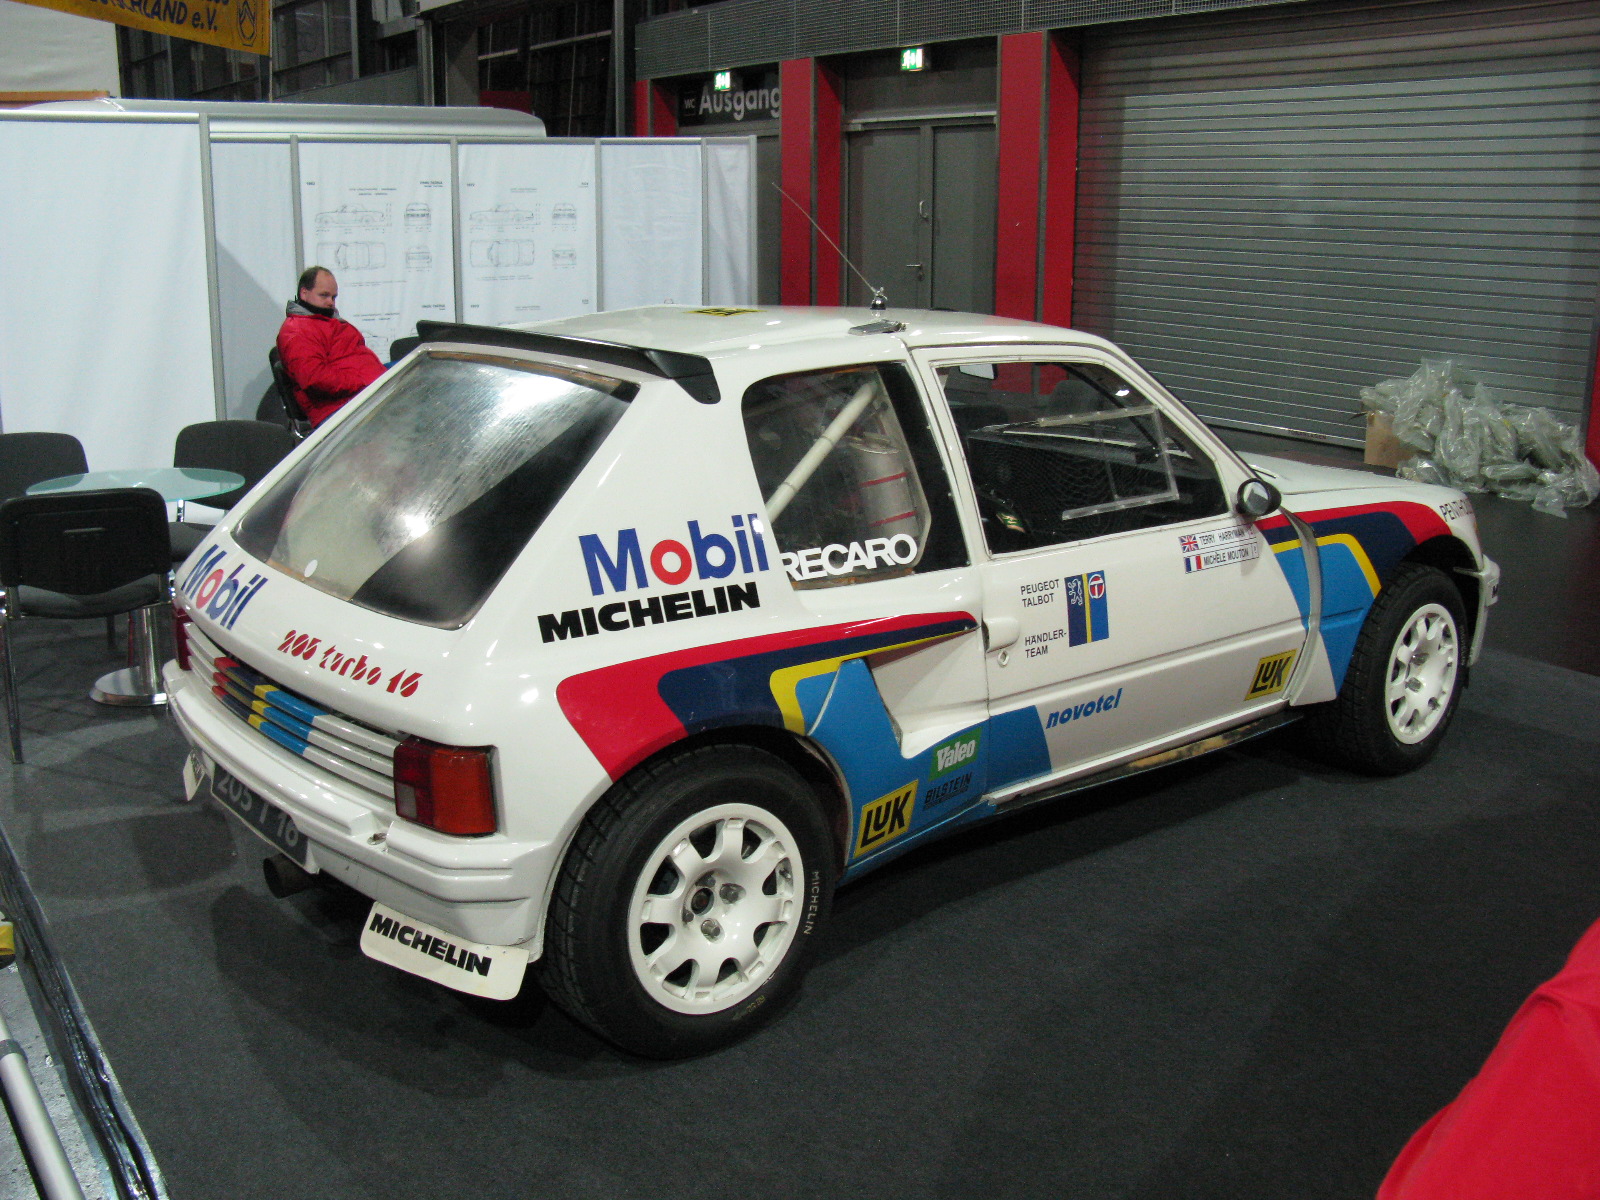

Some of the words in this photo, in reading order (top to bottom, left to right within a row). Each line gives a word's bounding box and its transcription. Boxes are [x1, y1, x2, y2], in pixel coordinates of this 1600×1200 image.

[191, 8, 218, 32] e.V.
[684, 99, 696, 109] WC
[699, 86, 781, 120] Ausgang
[1199, 535, 1216, 546] TERRY
[1218, 529, 1245, 542] HARRYMAN
[578, 513, 770, 596] Mobil
[780, 533, 918, 582] RECARO
[1203, 551, 1226, 565] MICHÈLE
[1227, 548, 1249, 561] MOUTON
[180, 544, 269, 631] Mobil
[1020, 579, 1060, 596] PEUGEOT
[1022, 593, 1055, 607] TALBOT
[537, 581, 761, 643] MICHELIN
[1024, 629, 1067, 646] HÄNDLER-
[1025, 645, 1049, 658] TEAM
[277, 629, 322, 661] 205
[319, 644, 382, 685] turbo
[386, 668, 423, 698] 16
[1045, 687, 1123, 729] novotel
[936, 740, 976, 772] Valeo
[925, 772, 973, 804] BILSTEIN
[276, 811, 300, 847] 16
[803, 871, 820, 935] MICHELIN
[368, 913, 492, 977] MICHELIN
